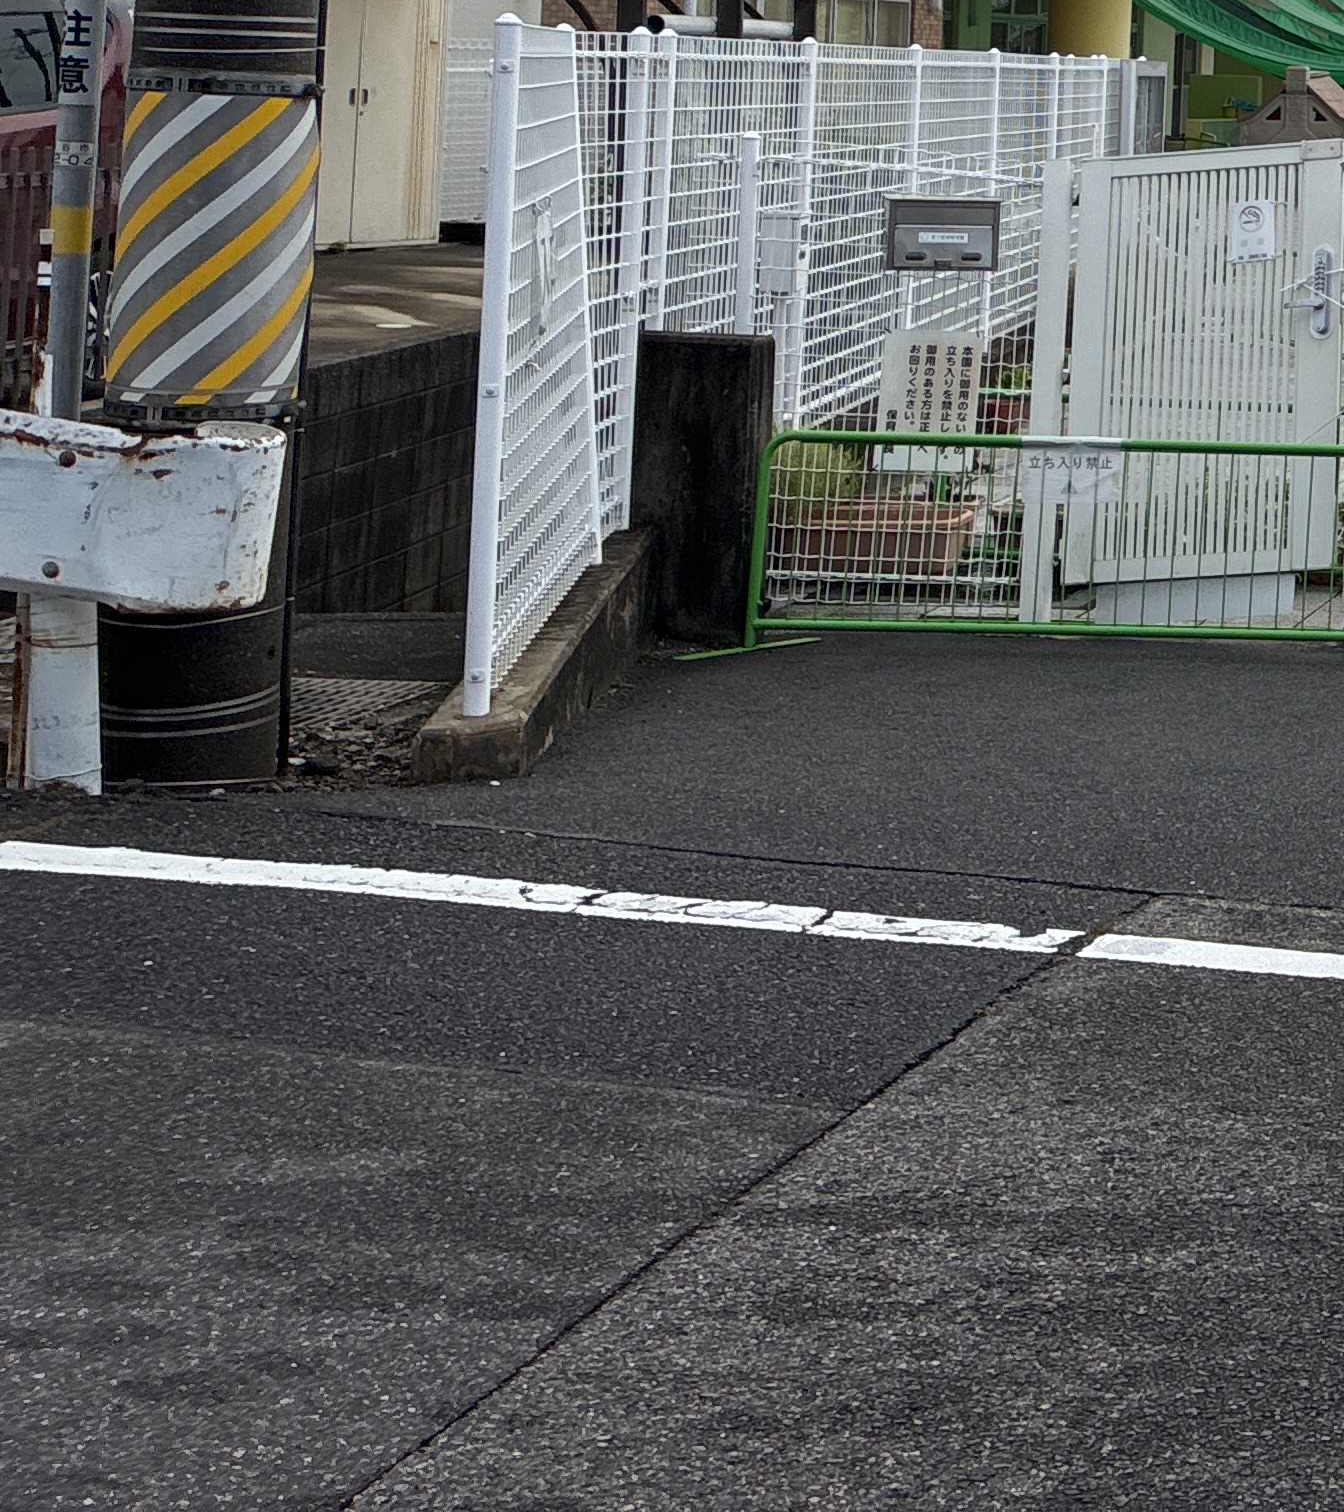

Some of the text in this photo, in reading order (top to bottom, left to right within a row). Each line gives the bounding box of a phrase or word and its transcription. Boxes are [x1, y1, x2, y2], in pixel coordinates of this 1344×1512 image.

[917, 345, 938, 454] 御用のある方は正へ
[953, 346, 974, 455] 本園に御用のないの
[1028, 455, 1113, 470] 立ち入り禁止
